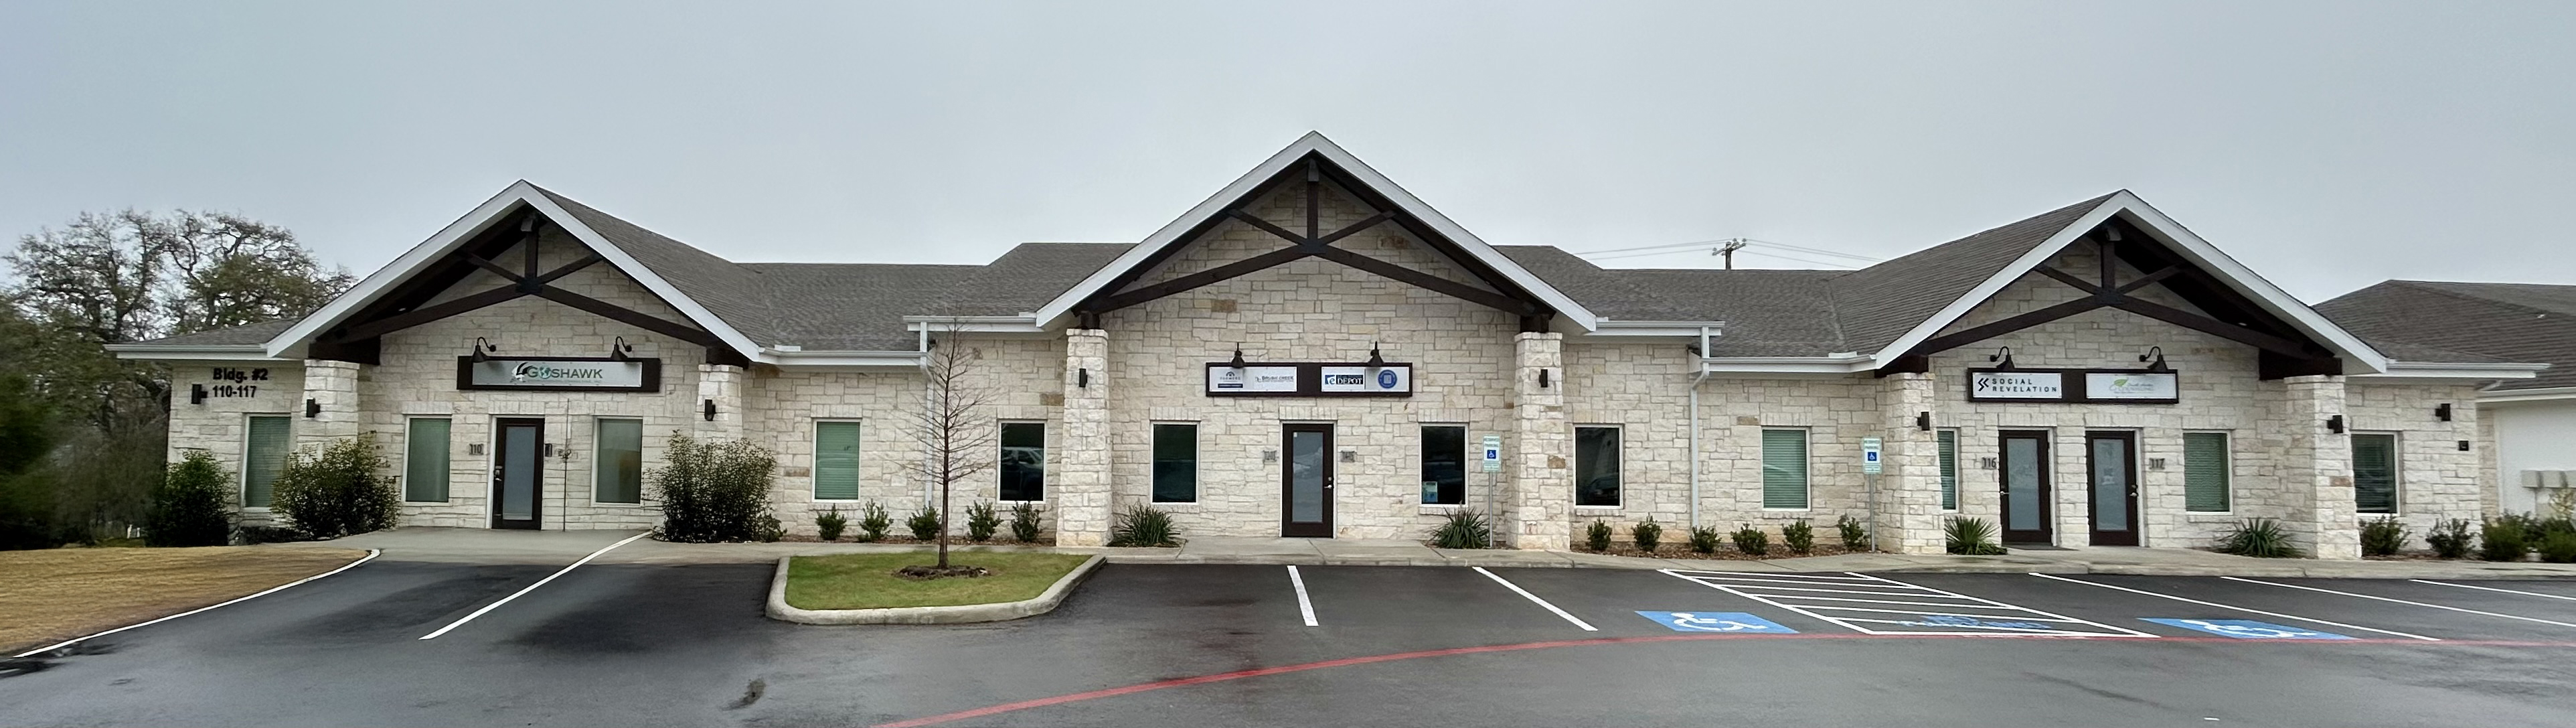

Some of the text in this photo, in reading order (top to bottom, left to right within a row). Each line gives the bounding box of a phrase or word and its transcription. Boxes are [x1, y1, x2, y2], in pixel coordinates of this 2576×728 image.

[213, 368, 268, 383] Bldg. #2
[213, 385, 257, 398] 110-117
[1982, 457, 1997, 468] 116
